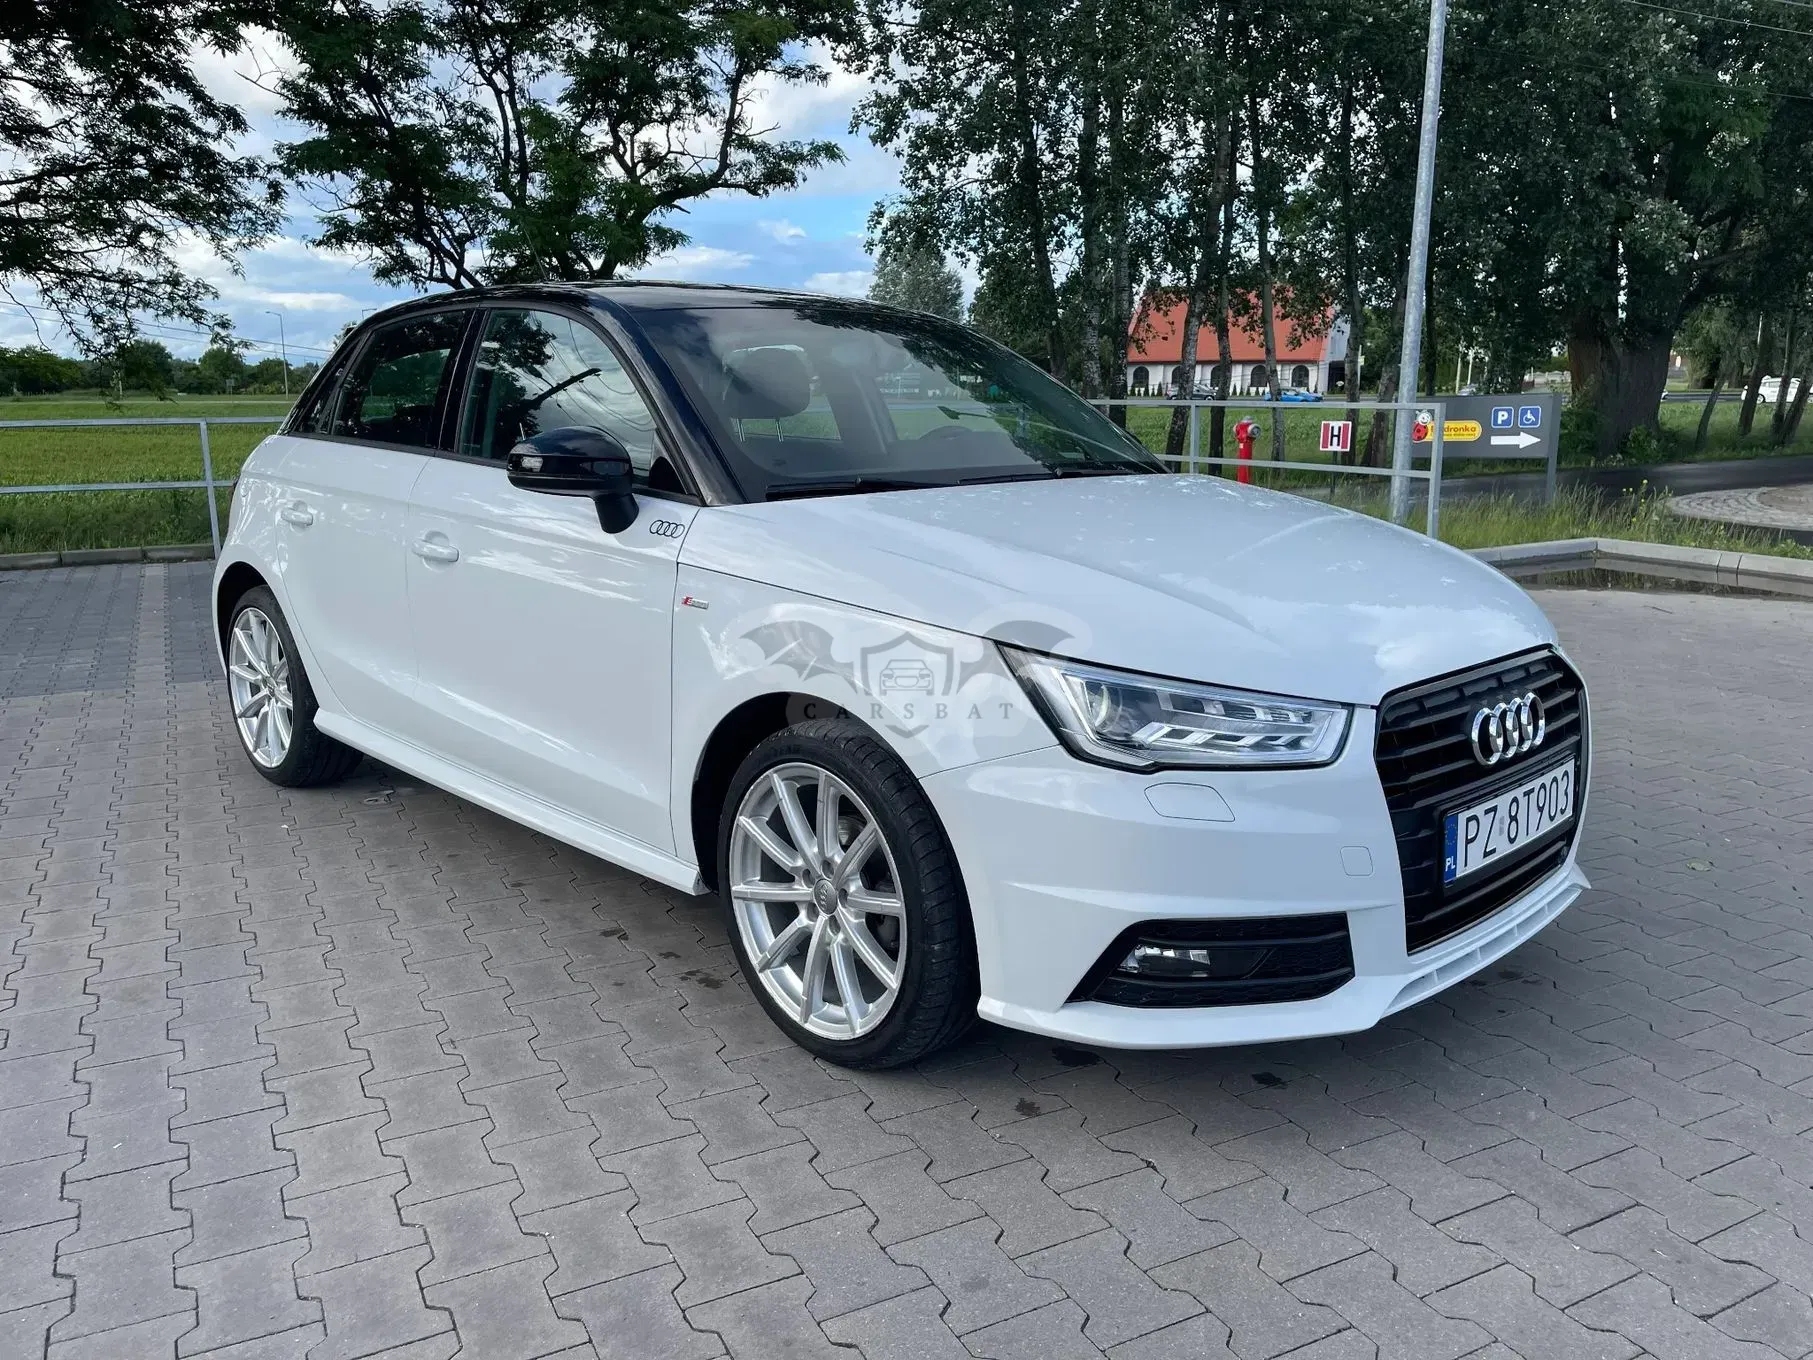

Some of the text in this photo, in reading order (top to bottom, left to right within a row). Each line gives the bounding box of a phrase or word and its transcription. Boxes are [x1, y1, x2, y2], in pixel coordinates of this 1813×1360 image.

[1497, 411, 1509, 424] P
[1330, 425, 1342, 447] H
[1430, 424, 1477, 433] dronka
[1463, 769, 1570, 868] PZ 8T903
[1445, 855, 1456, 872] PL
